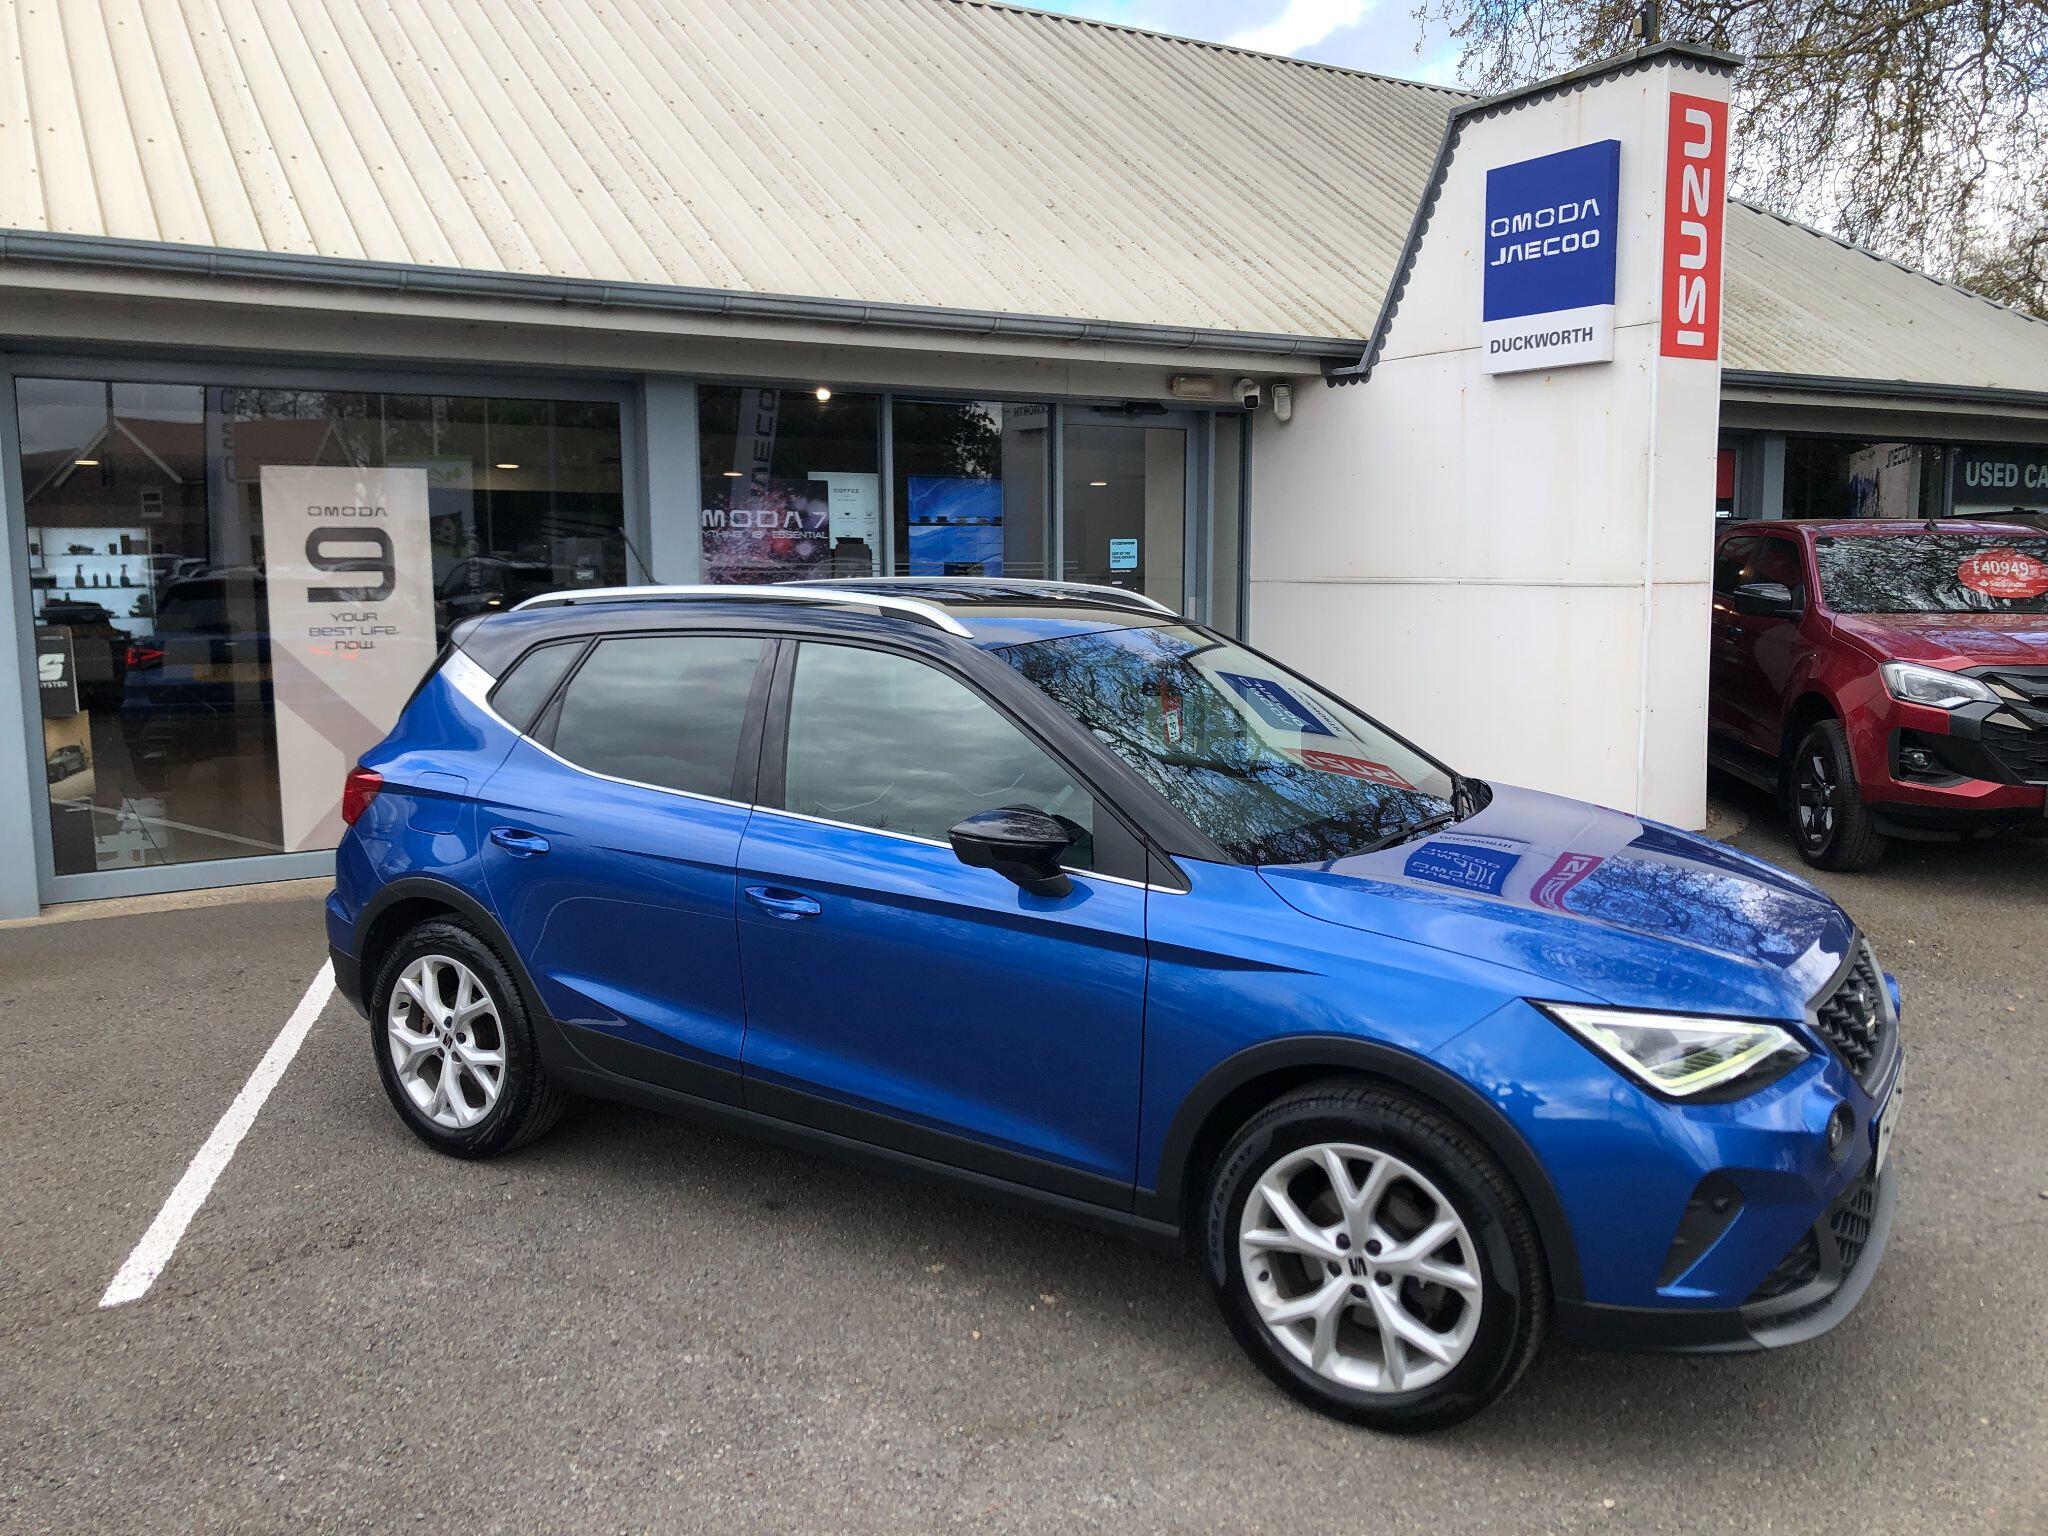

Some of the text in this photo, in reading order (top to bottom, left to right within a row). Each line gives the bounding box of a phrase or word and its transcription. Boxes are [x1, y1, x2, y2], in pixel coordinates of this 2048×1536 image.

[1491, 199, 1600, 237] OMODA
[1677, 108, 1712, 346] ISUZU
[1490, 229, 1600, 266] JAECOO
[1490, 327, 1593, 354] DUCKWORTH
[1965, 462, 2048, 488] USED CA
[307, 506, 387, 517] OMODA
[812, 512, 828, 528] 7
[772, 530, 829, 539] ESSENTIAL
[305, 526, 396, 603] 9
[1973, 560, 2029, 576] £40949
[330, 612, 378, 621] YOUR
